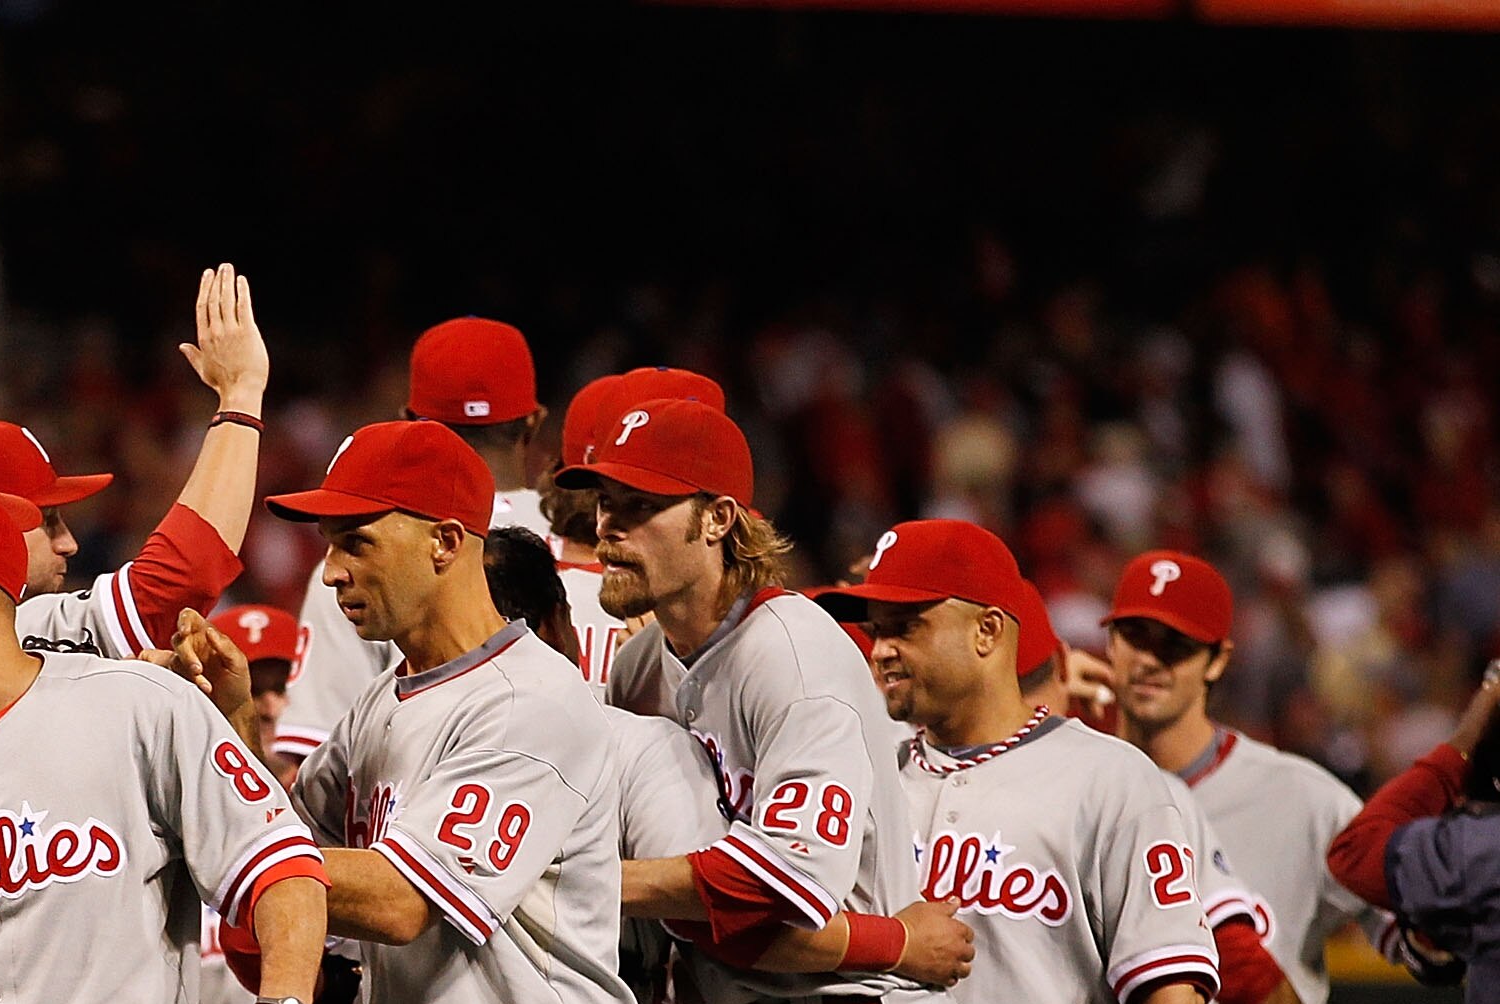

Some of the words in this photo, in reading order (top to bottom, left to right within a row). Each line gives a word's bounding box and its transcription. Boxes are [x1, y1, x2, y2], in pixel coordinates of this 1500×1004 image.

[615, 410, 650, 447] P
[869, 531, 899, 571] P
[1150, 560, 1181, 596] P
[211, 739, 273, 804] 8
[435, 783, 532, 871] 29
[758, 779, 853, 848] 28
